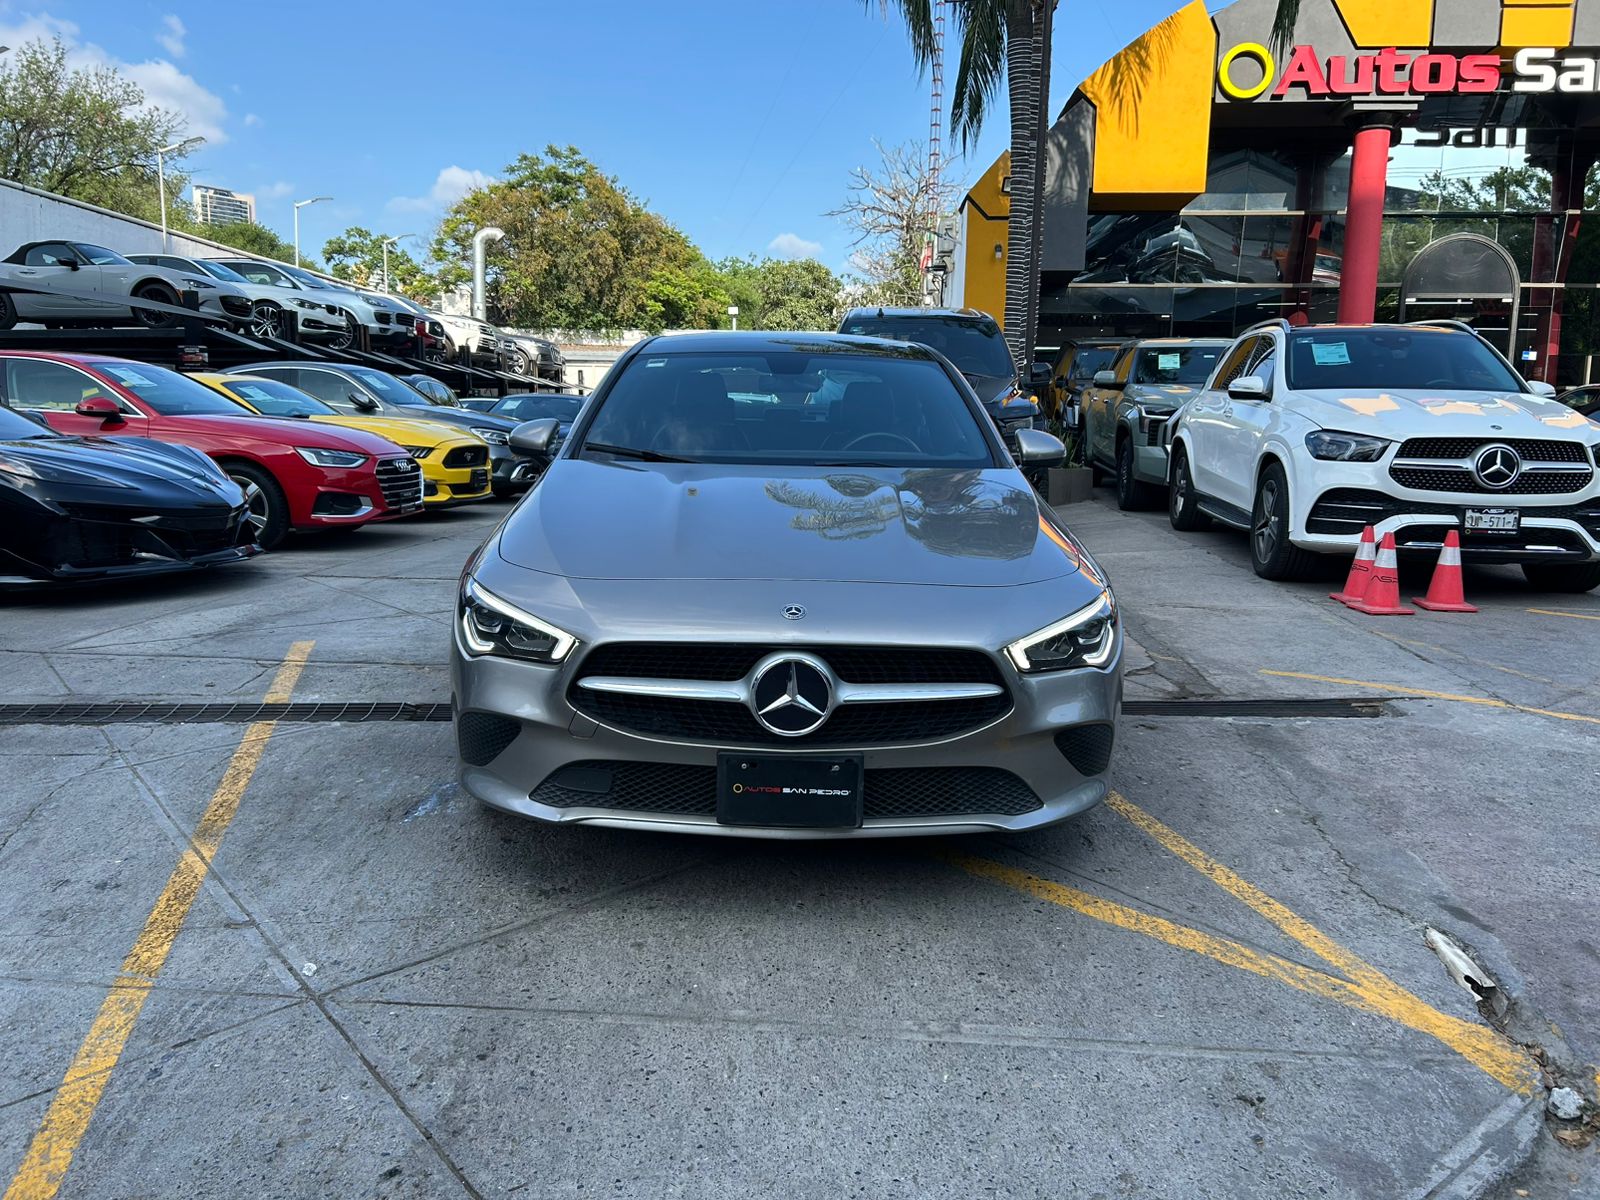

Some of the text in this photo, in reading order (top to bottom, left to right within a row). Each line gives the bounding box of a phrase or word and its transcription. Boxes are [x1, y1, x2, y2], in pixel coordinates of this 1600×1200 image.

[1273, 45, 1600, 95] Autos Sa
[743, 786, 849, 796] AUTOS SAN PEDRO
